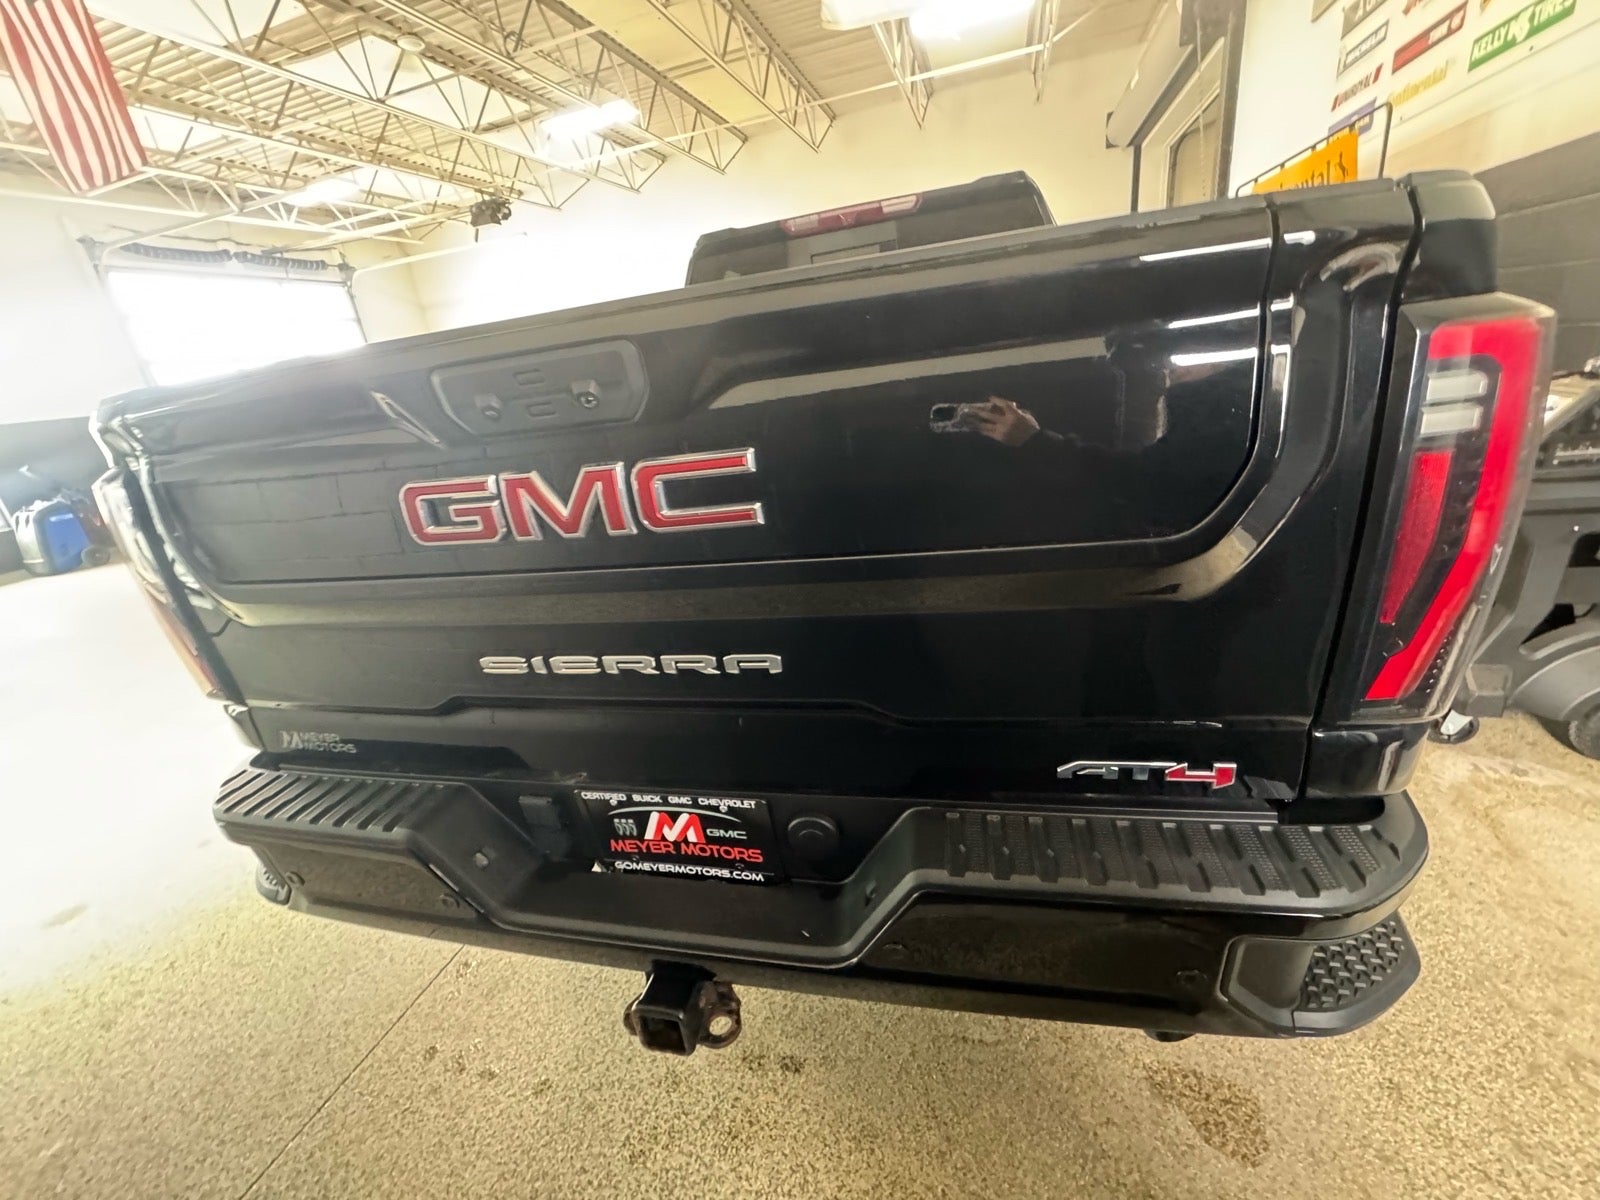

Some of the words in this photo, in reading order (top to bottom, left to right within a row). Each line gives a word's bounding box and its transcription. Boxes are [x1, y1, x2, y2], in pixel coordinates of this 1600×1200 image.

[1471, 22, 1509, 62] KELLY
[399, 447, 765, 546] GMC
[479, 654, 783, 676] SIERRA
[301, 731, 340, 742] MEYER
[303, 741, 357, 754] MOTORS
[1056, 761, 1238, 790] AT4
[581, 791, 627, 802] CERTIFIED
[632, 794, 662, 804] BUICK
[667, 796, 692, 805] GMC
[698, 797, 756, 809] CHEVROLET
[706, 828, 748, 840] GMC
[610, 839, 675, 854] MEYER
[680, 842, 764, 863] MOTORS
[614, 860, 765, 882] GOMEYERMOTORS.COM
